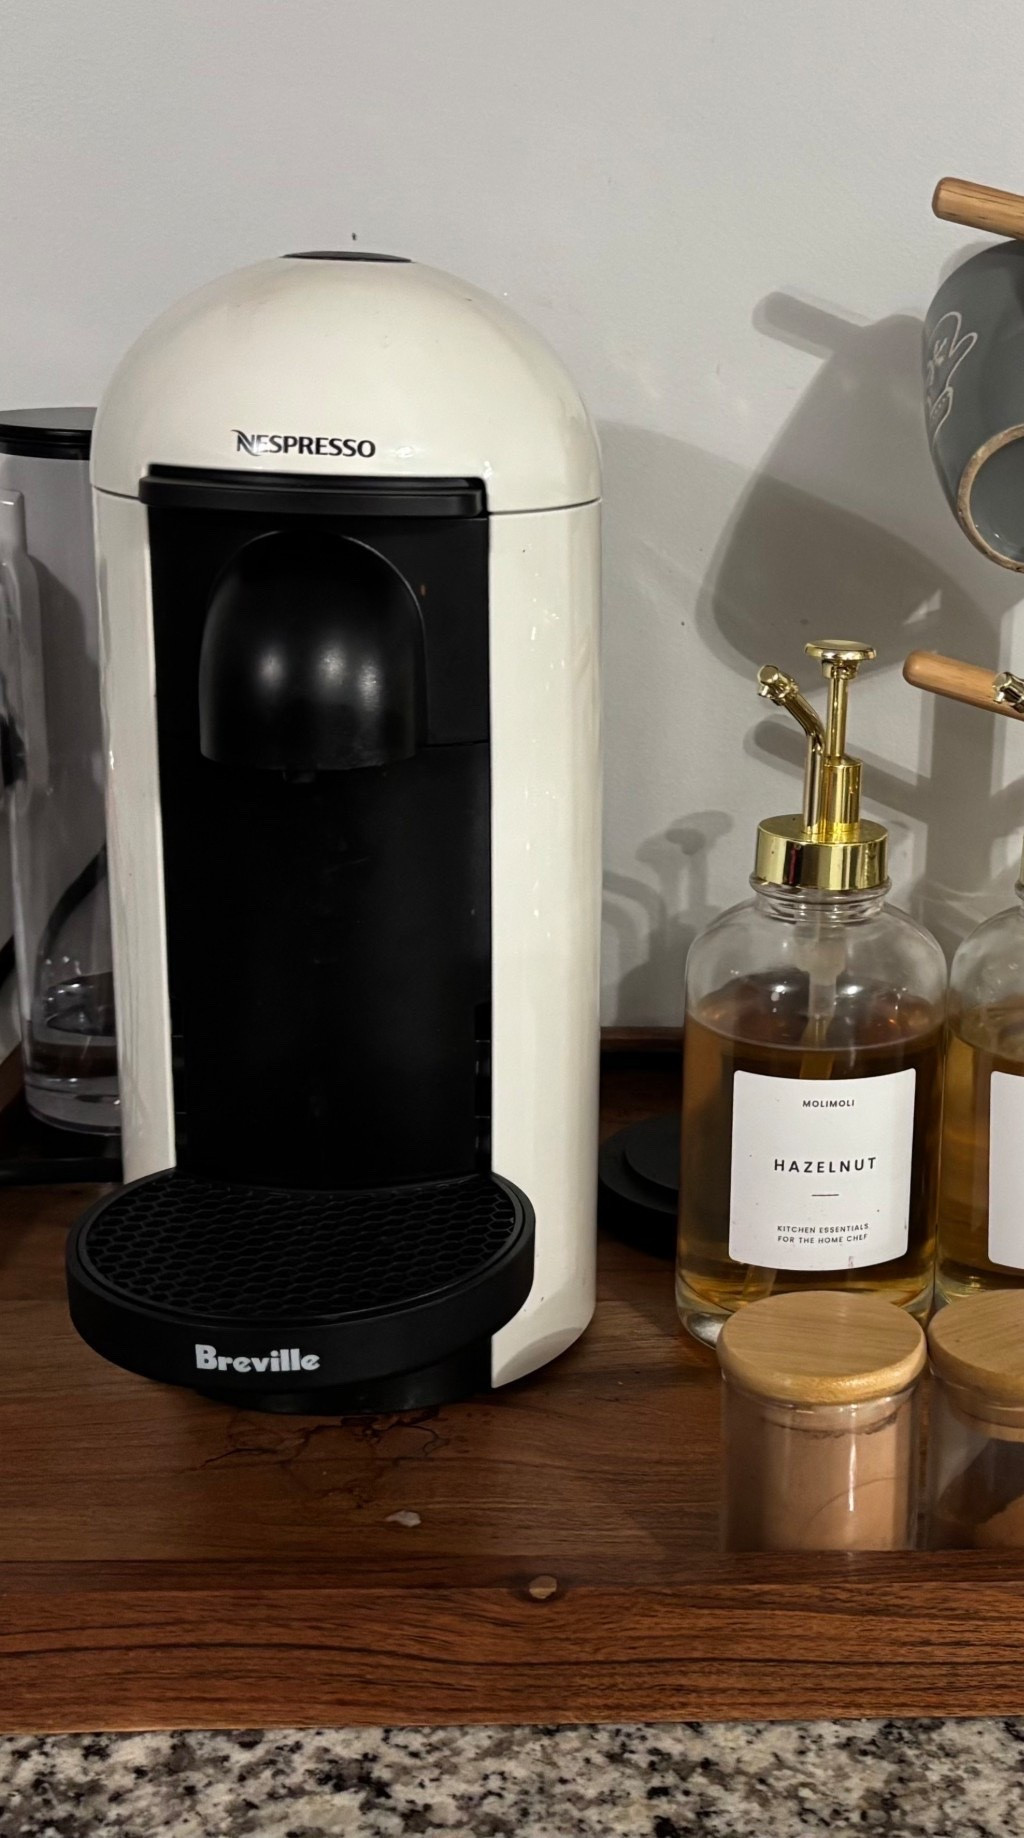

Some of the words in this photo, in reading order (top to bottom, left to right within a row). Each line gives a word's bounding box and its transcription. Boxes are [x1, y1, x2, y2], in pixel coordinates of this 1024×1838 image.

[231, 430, 376, 458] NESPRESSO
[802, 1100, 855, 1108] MOLIMOLI
[774, 1157, 877, 1173] HAZELNUT
[777, 1225, 816, 1233] KITCHEN
[819, 1223, 869, 1233] ESSENTIALS
[777, 1235, 795, 1243] FOR
[798, 1236, 815, 1244] THE
[817, 1236, 844, 1244] HOME
[846, 1233, 868, 1242] CHEF
[195, 1344, 321, 1373] Breville
